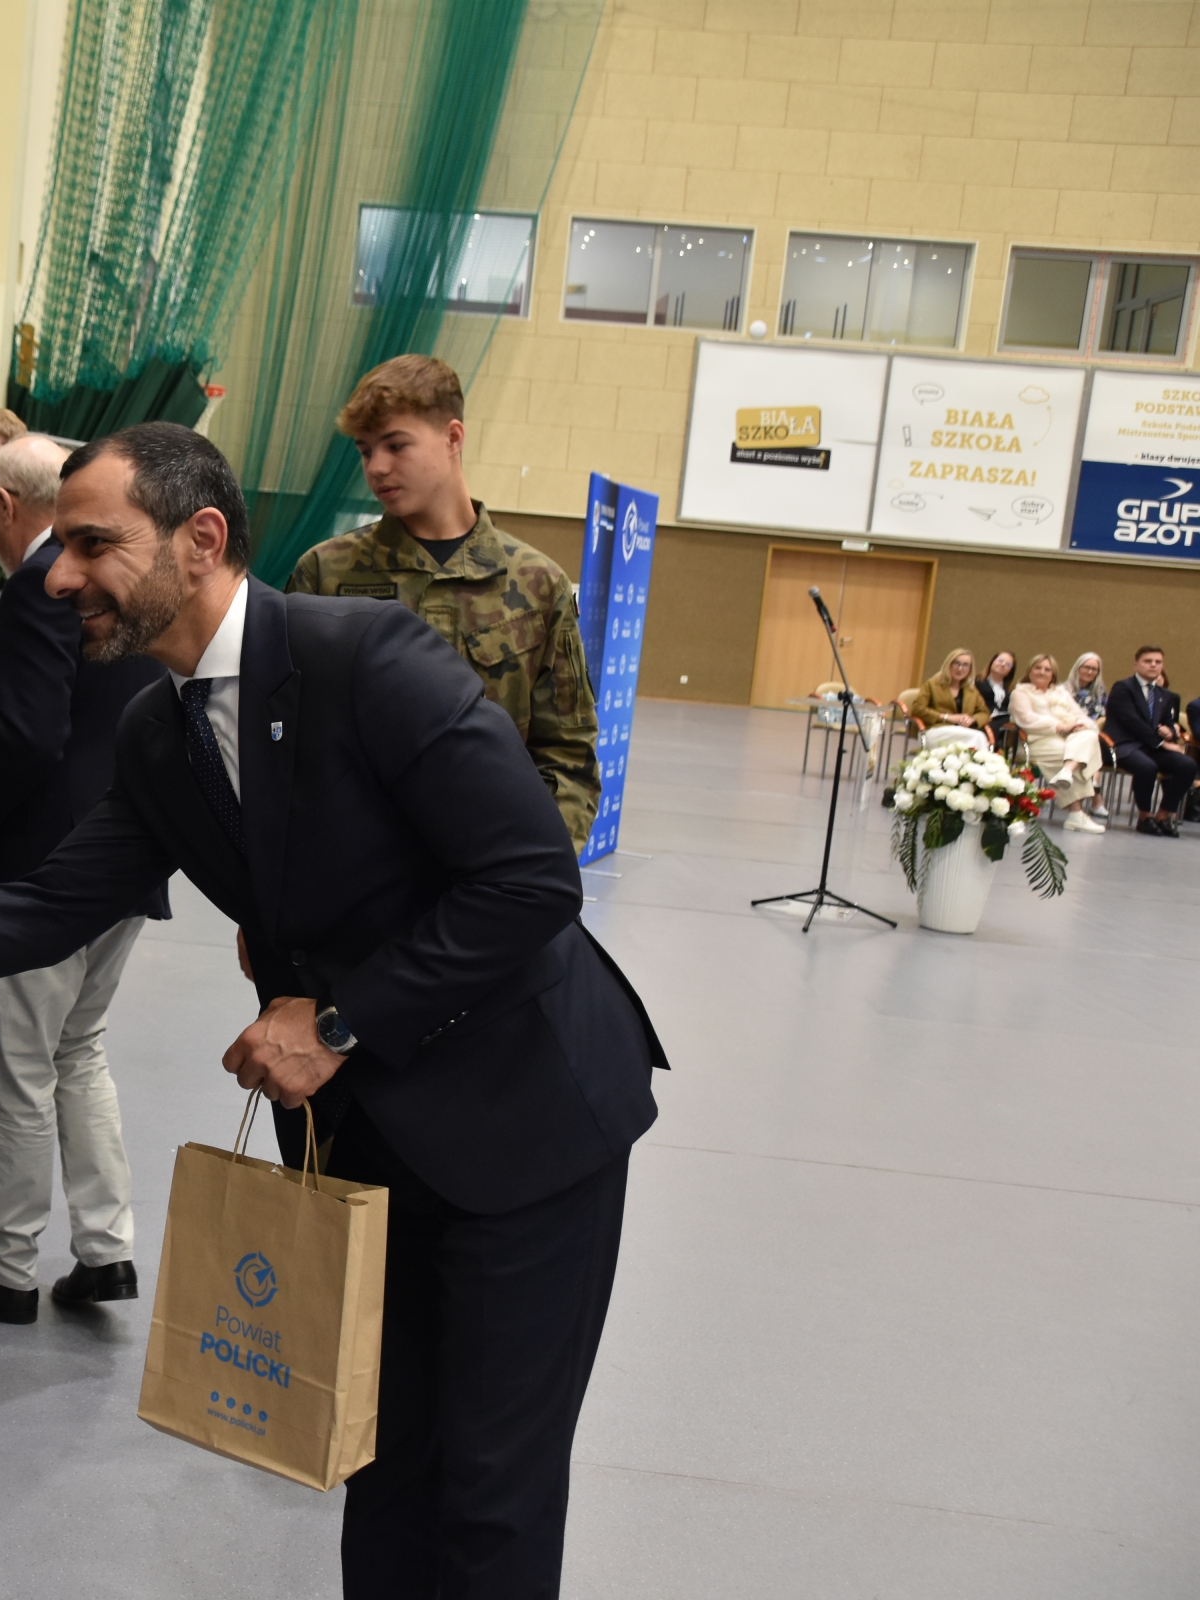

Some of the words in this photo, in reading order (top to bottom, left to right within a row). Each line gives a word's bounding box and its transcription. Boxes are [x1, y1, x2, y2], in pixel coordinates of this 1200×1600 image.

[945, 408, 1016, 431] BIAŁA
[931, 429, 1023, 453] SZKOŁA
[1141, 452, 1164, 463] klasy
[909, 460, 1037, 487] ZAPRASZA!
[216, 1305, 281, 1353] Powiat
[200, 1331, 291, 1389] POLICKI
[207, 1408, 266, 1436] www.policki.pl
